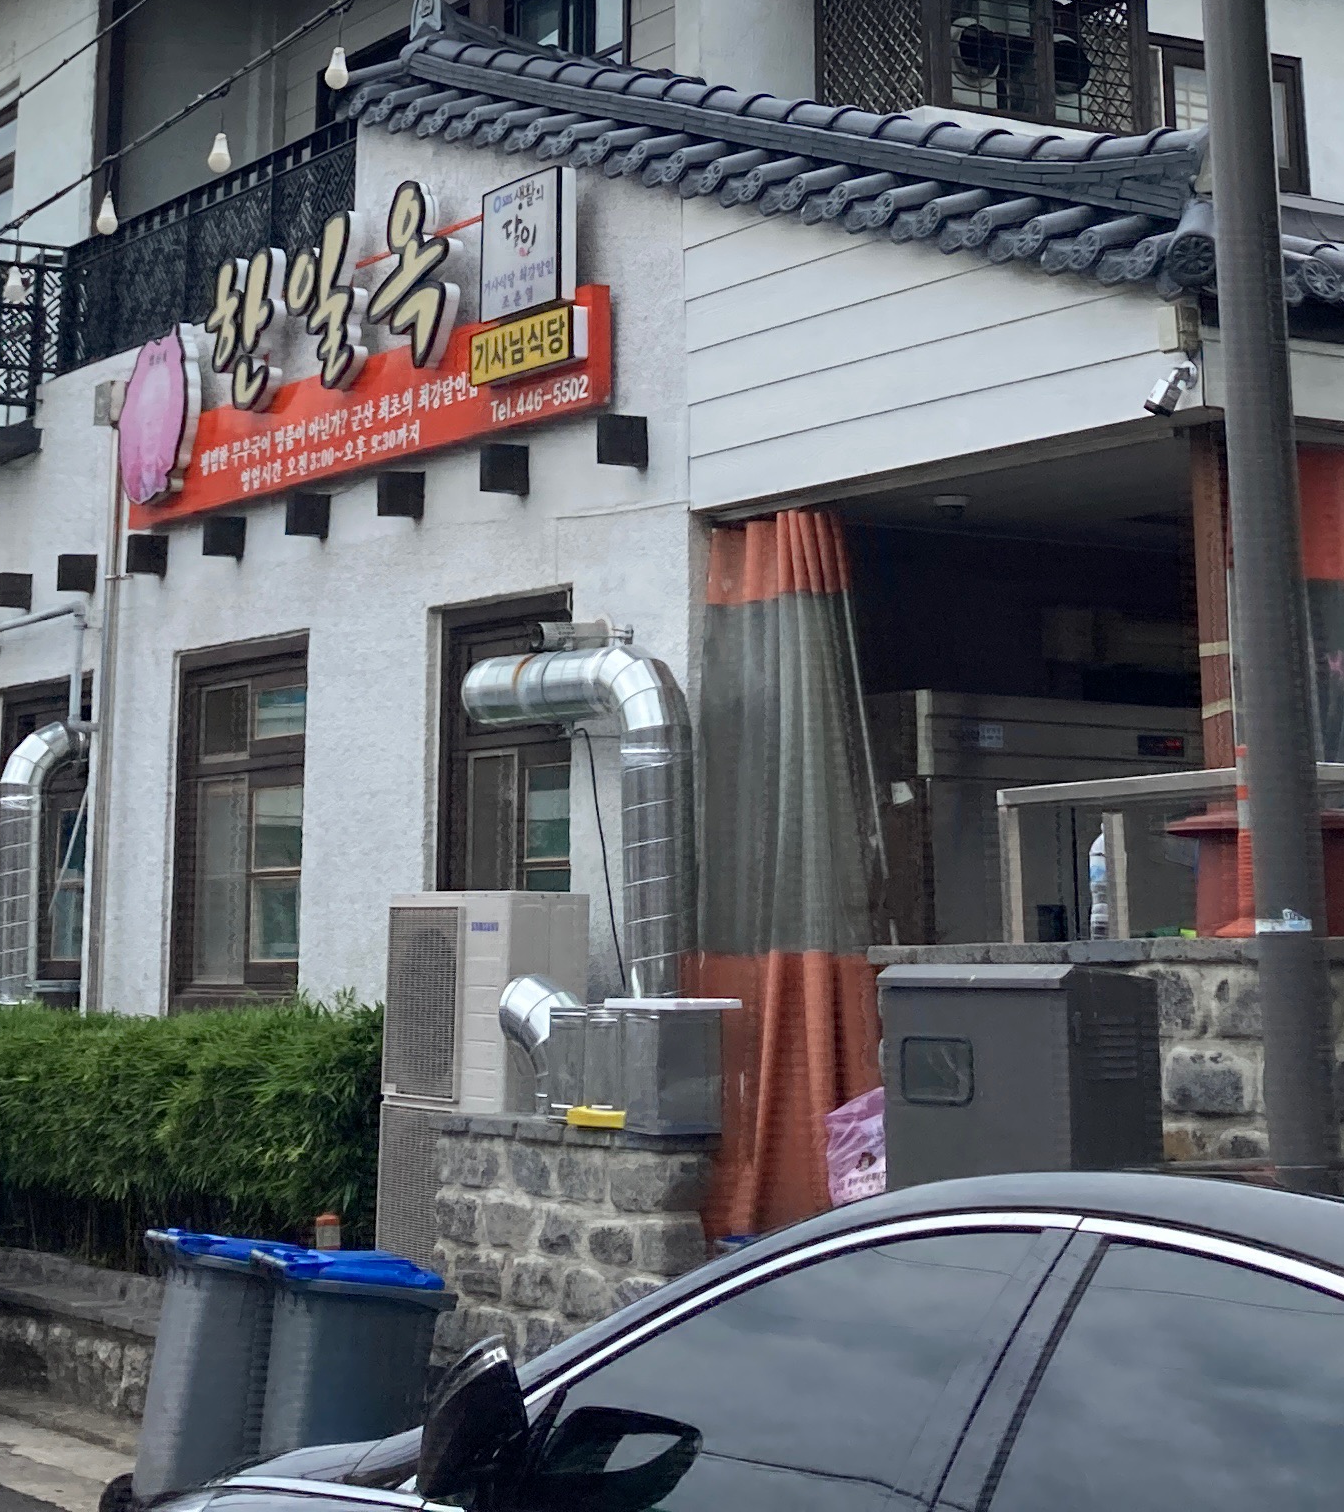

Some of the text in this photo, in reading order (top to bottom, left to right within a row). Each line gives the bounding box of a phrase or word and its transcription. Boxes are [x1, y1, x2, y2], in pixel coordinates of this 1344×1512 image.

[205, 180, 450, 410] 한일옥
[473, 313, 566, 375] 기사님식당
[231, 430, 271, 466] 무우국이
[274, 419, 306, 454] 명품이
[308, 408, 348, 445] 아닌가?
[351, 399, 376, 432] 군산
[377, 388, 414, 423] 최초의
[490, 374, 589, 423] Tel.446-5502
[240, 459, 283, 492] 영업시간
